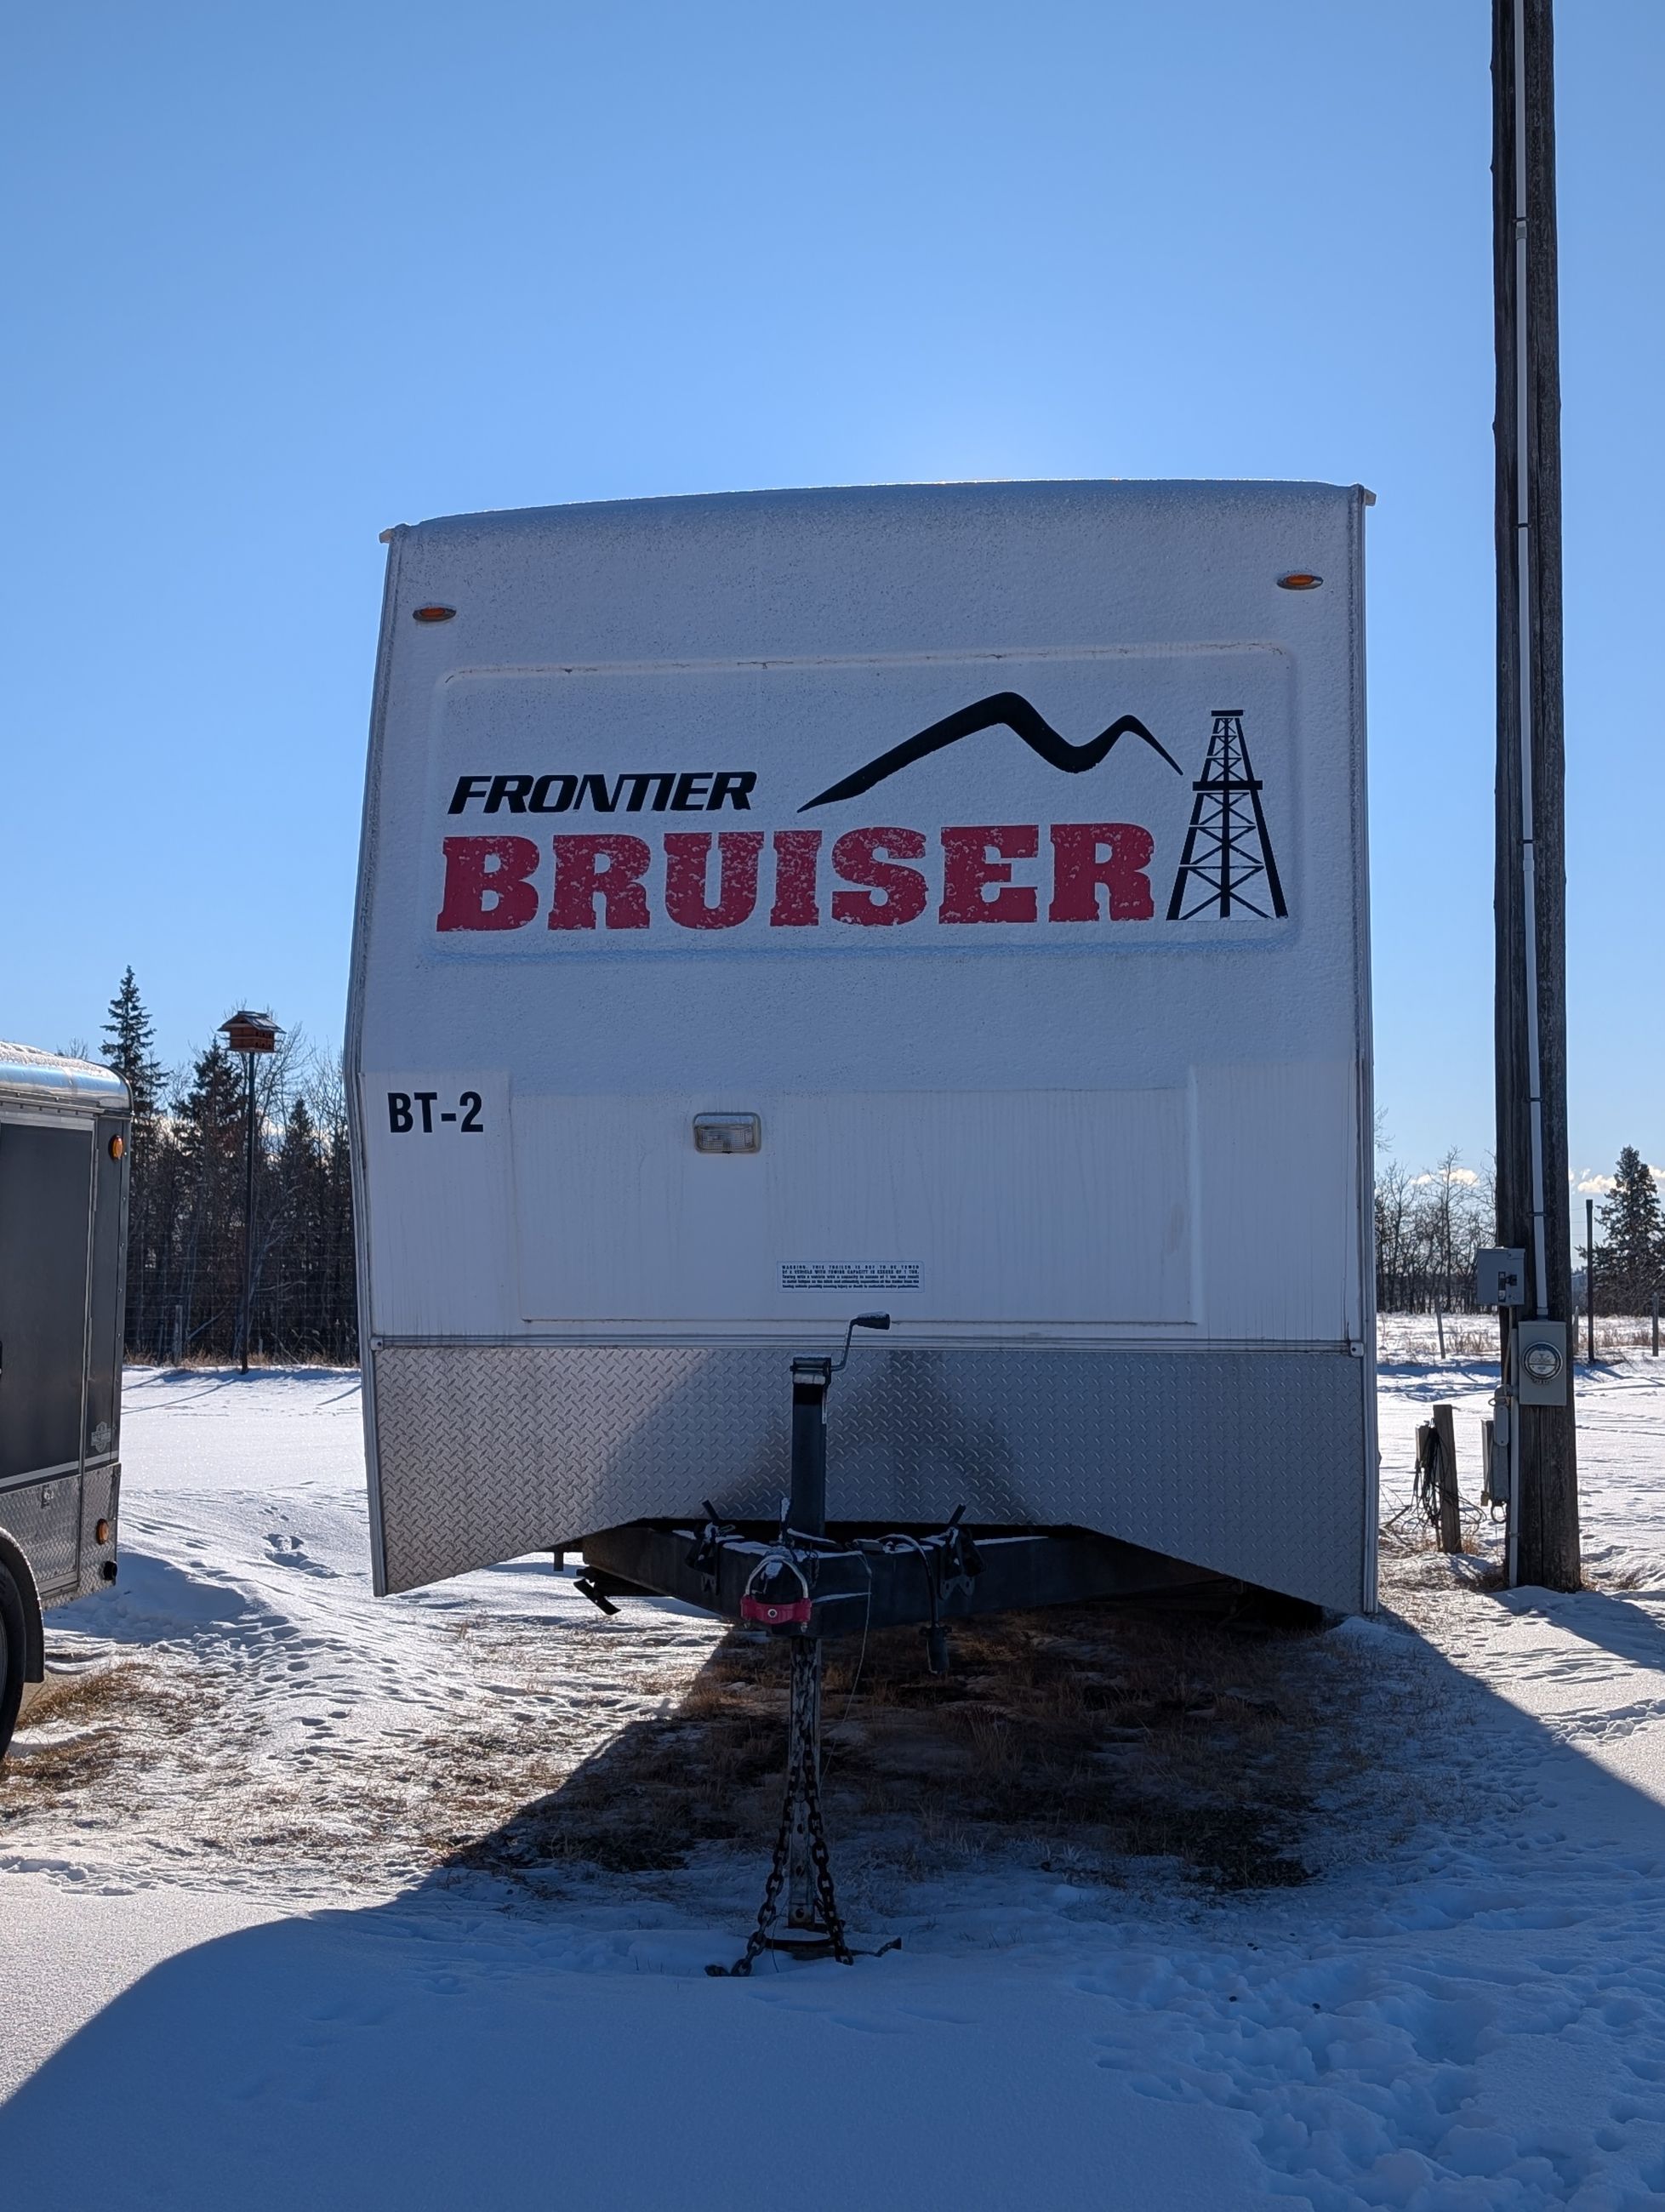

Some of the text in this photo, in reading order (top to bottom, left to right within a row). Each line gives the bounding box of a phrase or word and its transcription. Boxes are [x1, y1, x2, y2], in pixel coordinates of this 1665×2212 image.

[447, 771, 757, 815] FRONTIER
[436, 823, 1154, 932] BRUISER
[387, 1091, 484, 1133] BT-2
